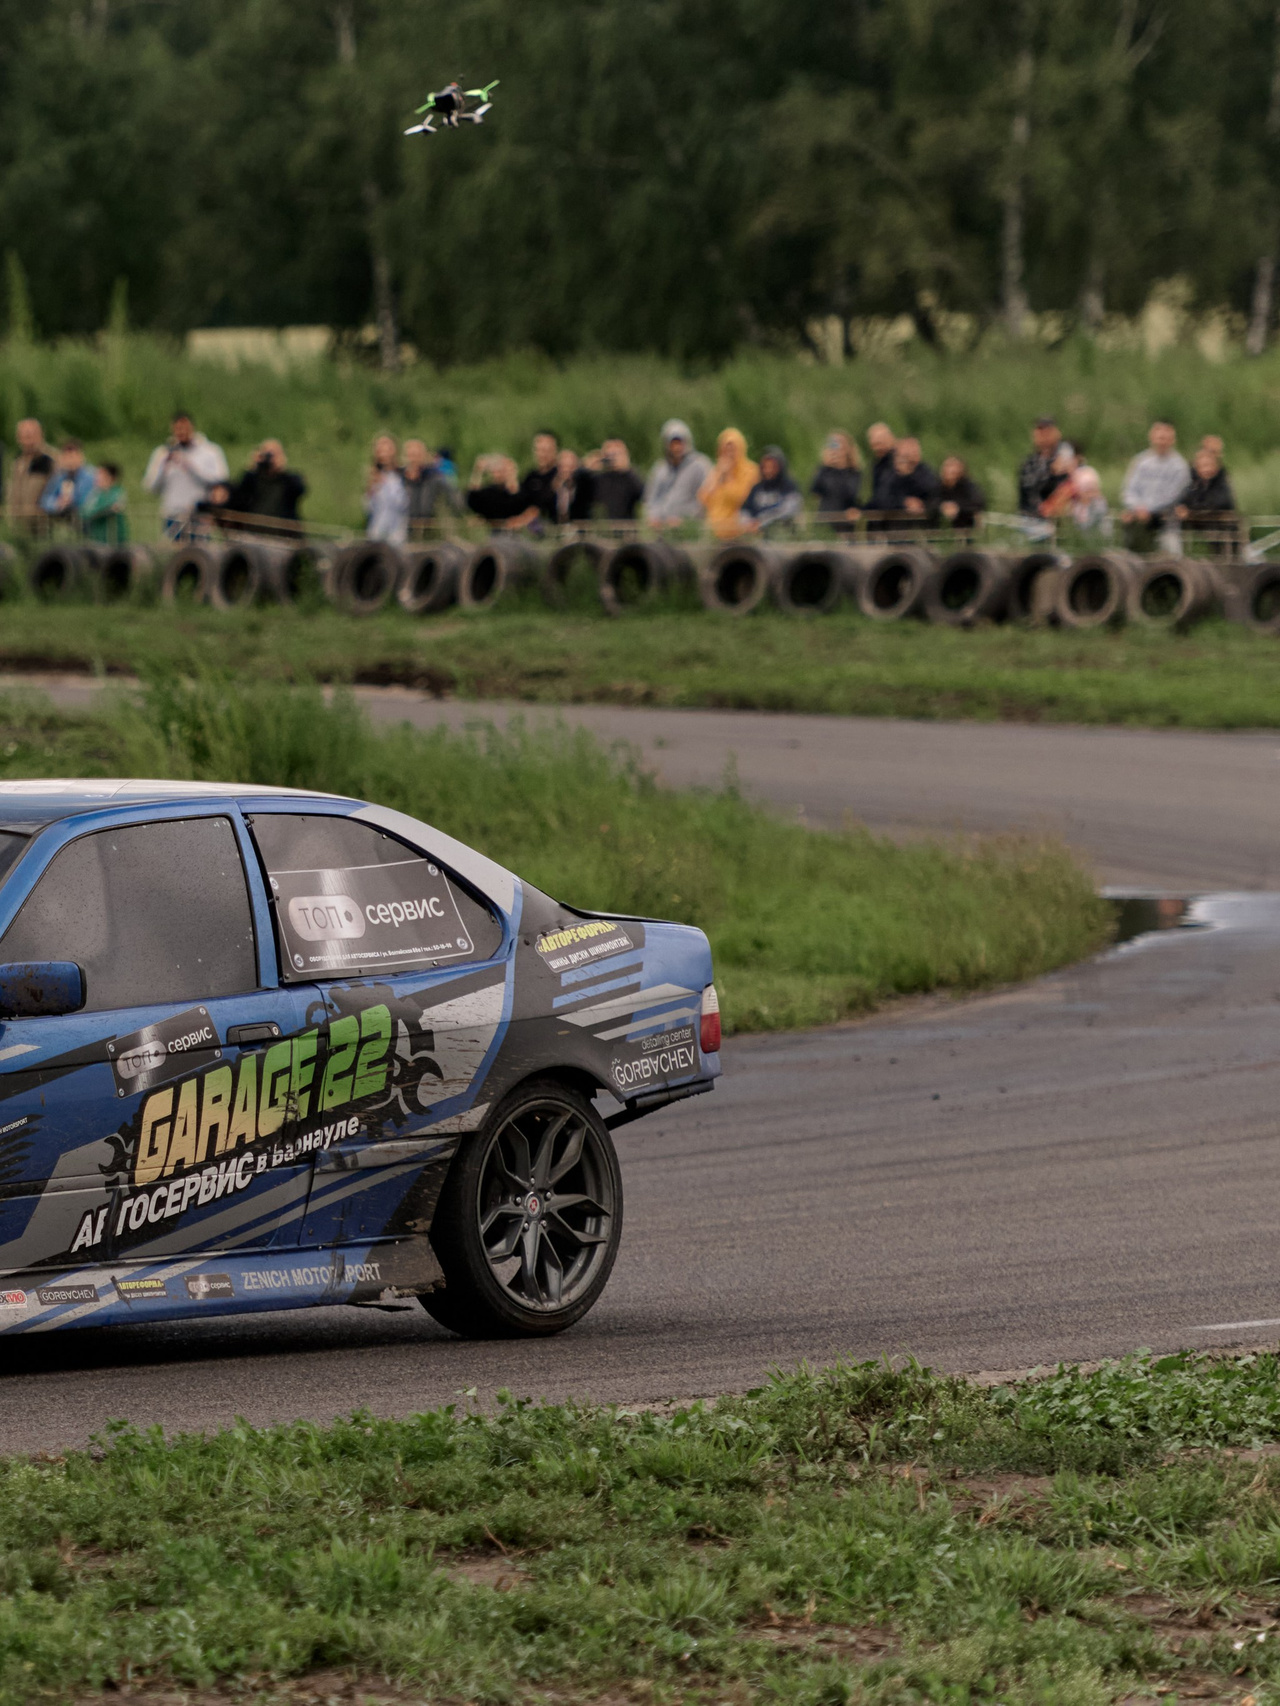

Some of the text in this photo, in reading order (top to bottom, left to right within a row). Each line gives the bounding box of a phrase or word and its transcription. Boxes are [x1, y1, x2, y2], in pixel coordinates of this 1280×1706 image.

[298, 896, 445, 930] ТОП сервис
[568, 949, 590, 965] ДИСКИ
[123, 1026, 213, 1072] ТОП сервис
[641, 1028, 692, 1051] detailing center
[134, 1004, 393, 1188] GARAGE 22
[256, 1152, 268, 1174] в
[210, 1281, 231, 1291] сервис
[240, 1269, 291, 1290] ZENICH
